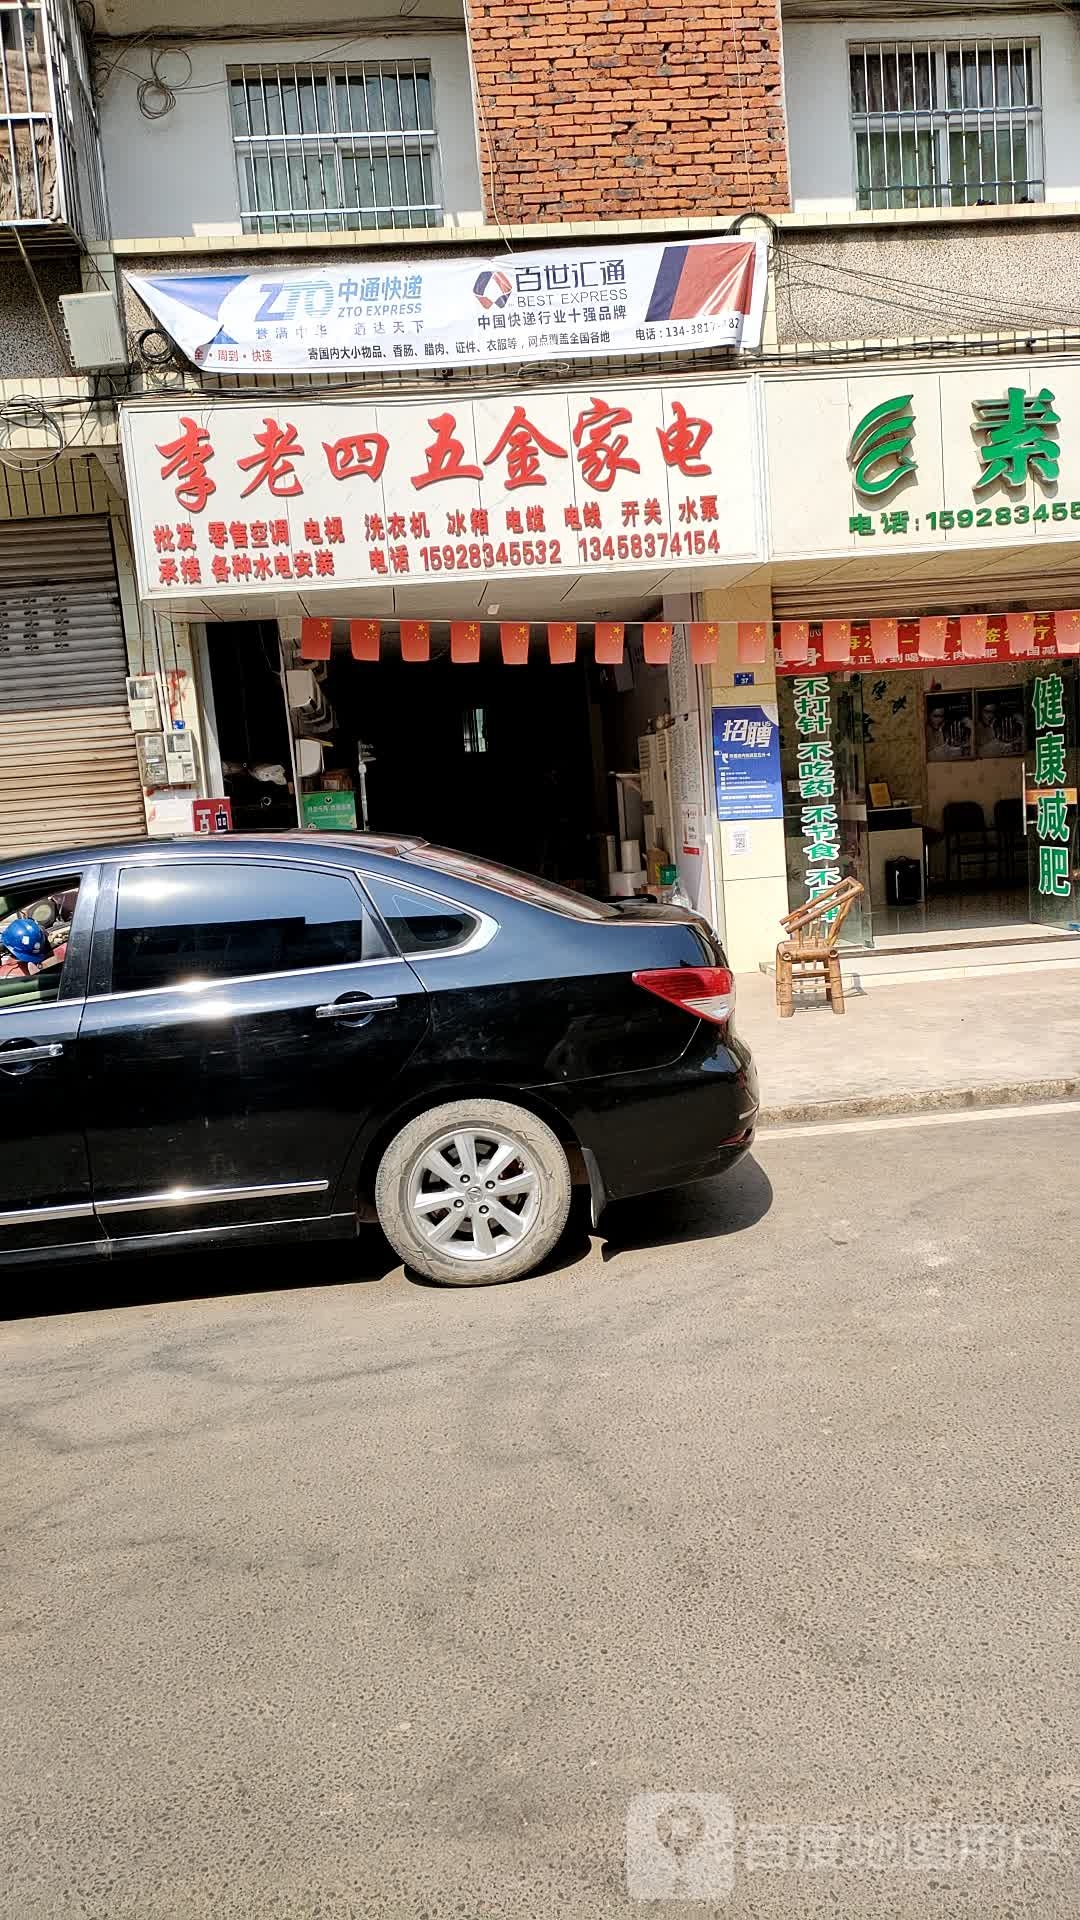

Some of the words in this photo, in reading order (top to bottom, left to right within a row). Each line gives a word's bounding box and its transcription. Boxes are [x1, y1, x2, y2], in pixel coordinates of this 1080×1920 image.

[254, 279, 334, 322] ZTO
[338, 275, 422, 303] 中通快递
[515, 259, 627, 293] 百世汇通
[517, 293, 554, 309] BEST
[561, 287, 628, 305] EXPRESS
[338, 306, 363, 319] ZTO
[366, 302, 422, 317] EXPRESS
[477, 304, 627, 331] 中国快递行业十强品牌
[155, 397, 714, 514] 李老四五金家电
[969, 386, 1062, 488] 素
[153, 522, 198, 553] 批发
[208, 518, 290, 550] 零售空调
[304, 515, 346, 545] 电视
[365, 511, 431, 541] 洗衣机
[446, 507, 489, 537] 冰箱
[506, 505, 546, 535] 电缆
[564, 501, 602, 531] 电线
[621, 498, 662, 527] 开关
[678, 495, 720, 522] 水泵
[158, 555, 202, 585] 承接
[211, 548, 336, 584] 各种水电安装
[369, 543, 411, 576] 电话
[419, 539, 562, 572] 15928345532
[577, 529, 721, 563] 13458374154
[722, 719, 774, 748] 招聘
[792, 676, 833, 735] 不打针
[796, 740, 836, 799] 不吃药
[1032, 673, 1071, 897] 健康减肥
[801, 804, 841, 862] 不节食
